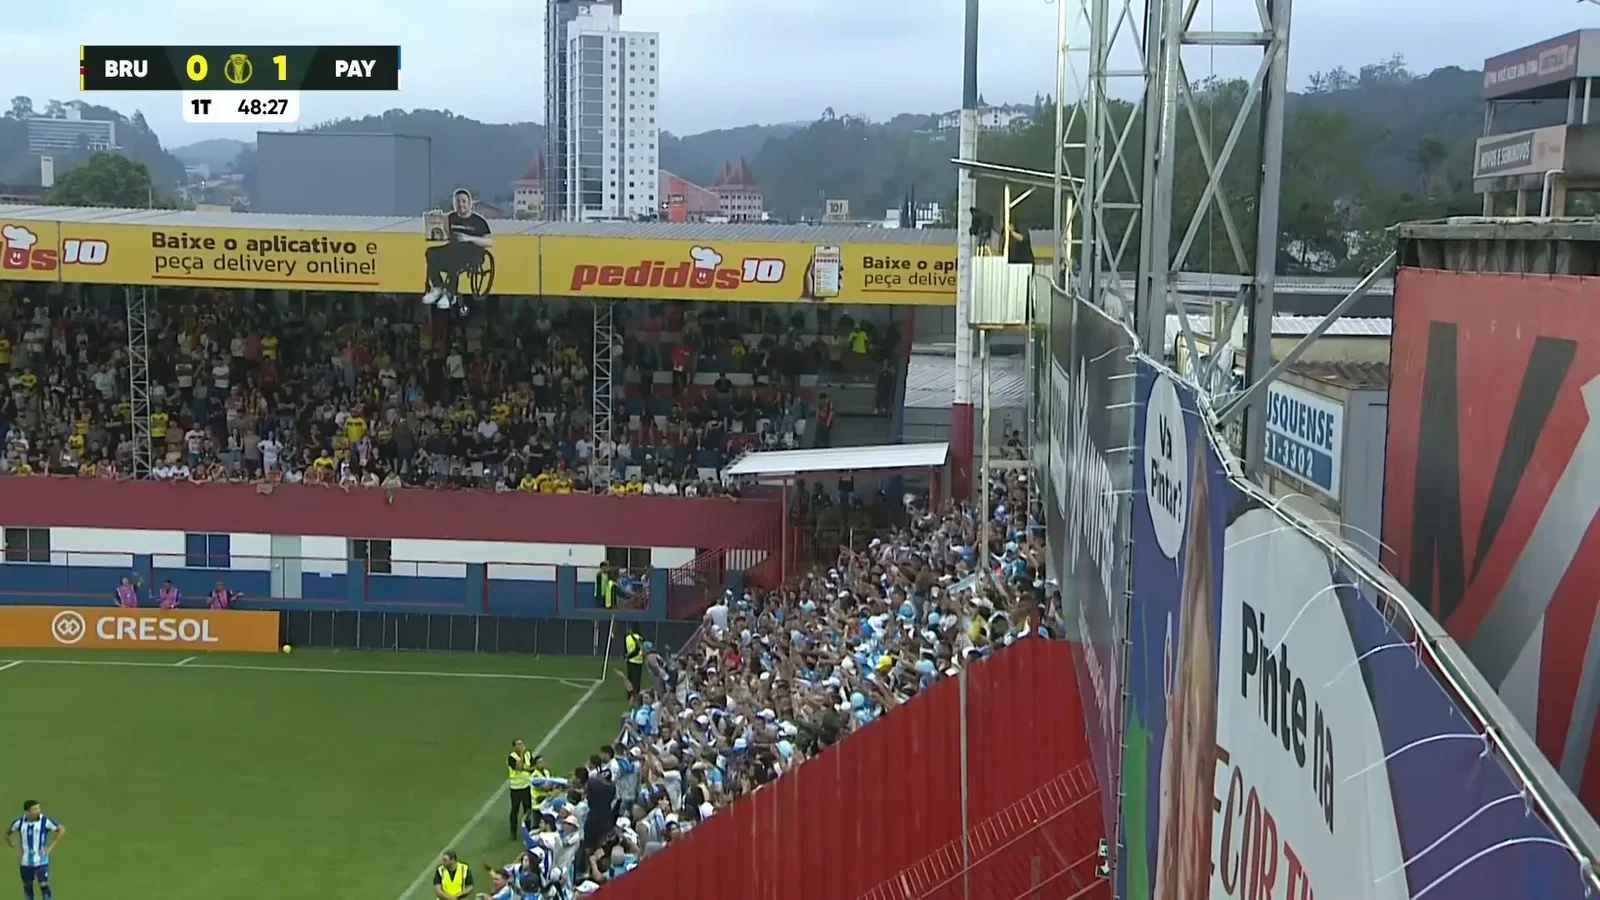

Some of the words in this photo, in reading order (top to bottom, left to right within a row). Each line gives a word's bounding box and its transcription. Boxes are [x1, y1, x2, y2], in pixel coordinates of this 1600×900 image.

[152, 232, 216, 250] Baixe
[224, 237, 237, 250] o
[246, 235, 356, 256] aplicativo
[366, 241, 377, 254] e
[155, 255, 204, 274] peça
[213, 253, 297, 276] delivery
[306, 256, 376, 275] online!
[863, 256, 911, 270] Baixe
[917, 260, 927, 270] o
[864, 273, 901, 288] peça
[1151, 457, 1182, 523] Pintar?
[96, 616, 219, 642] CRESOL
[1241, 601, 1307, 768] Pinte
[1312, 700, 1334, 835] na
